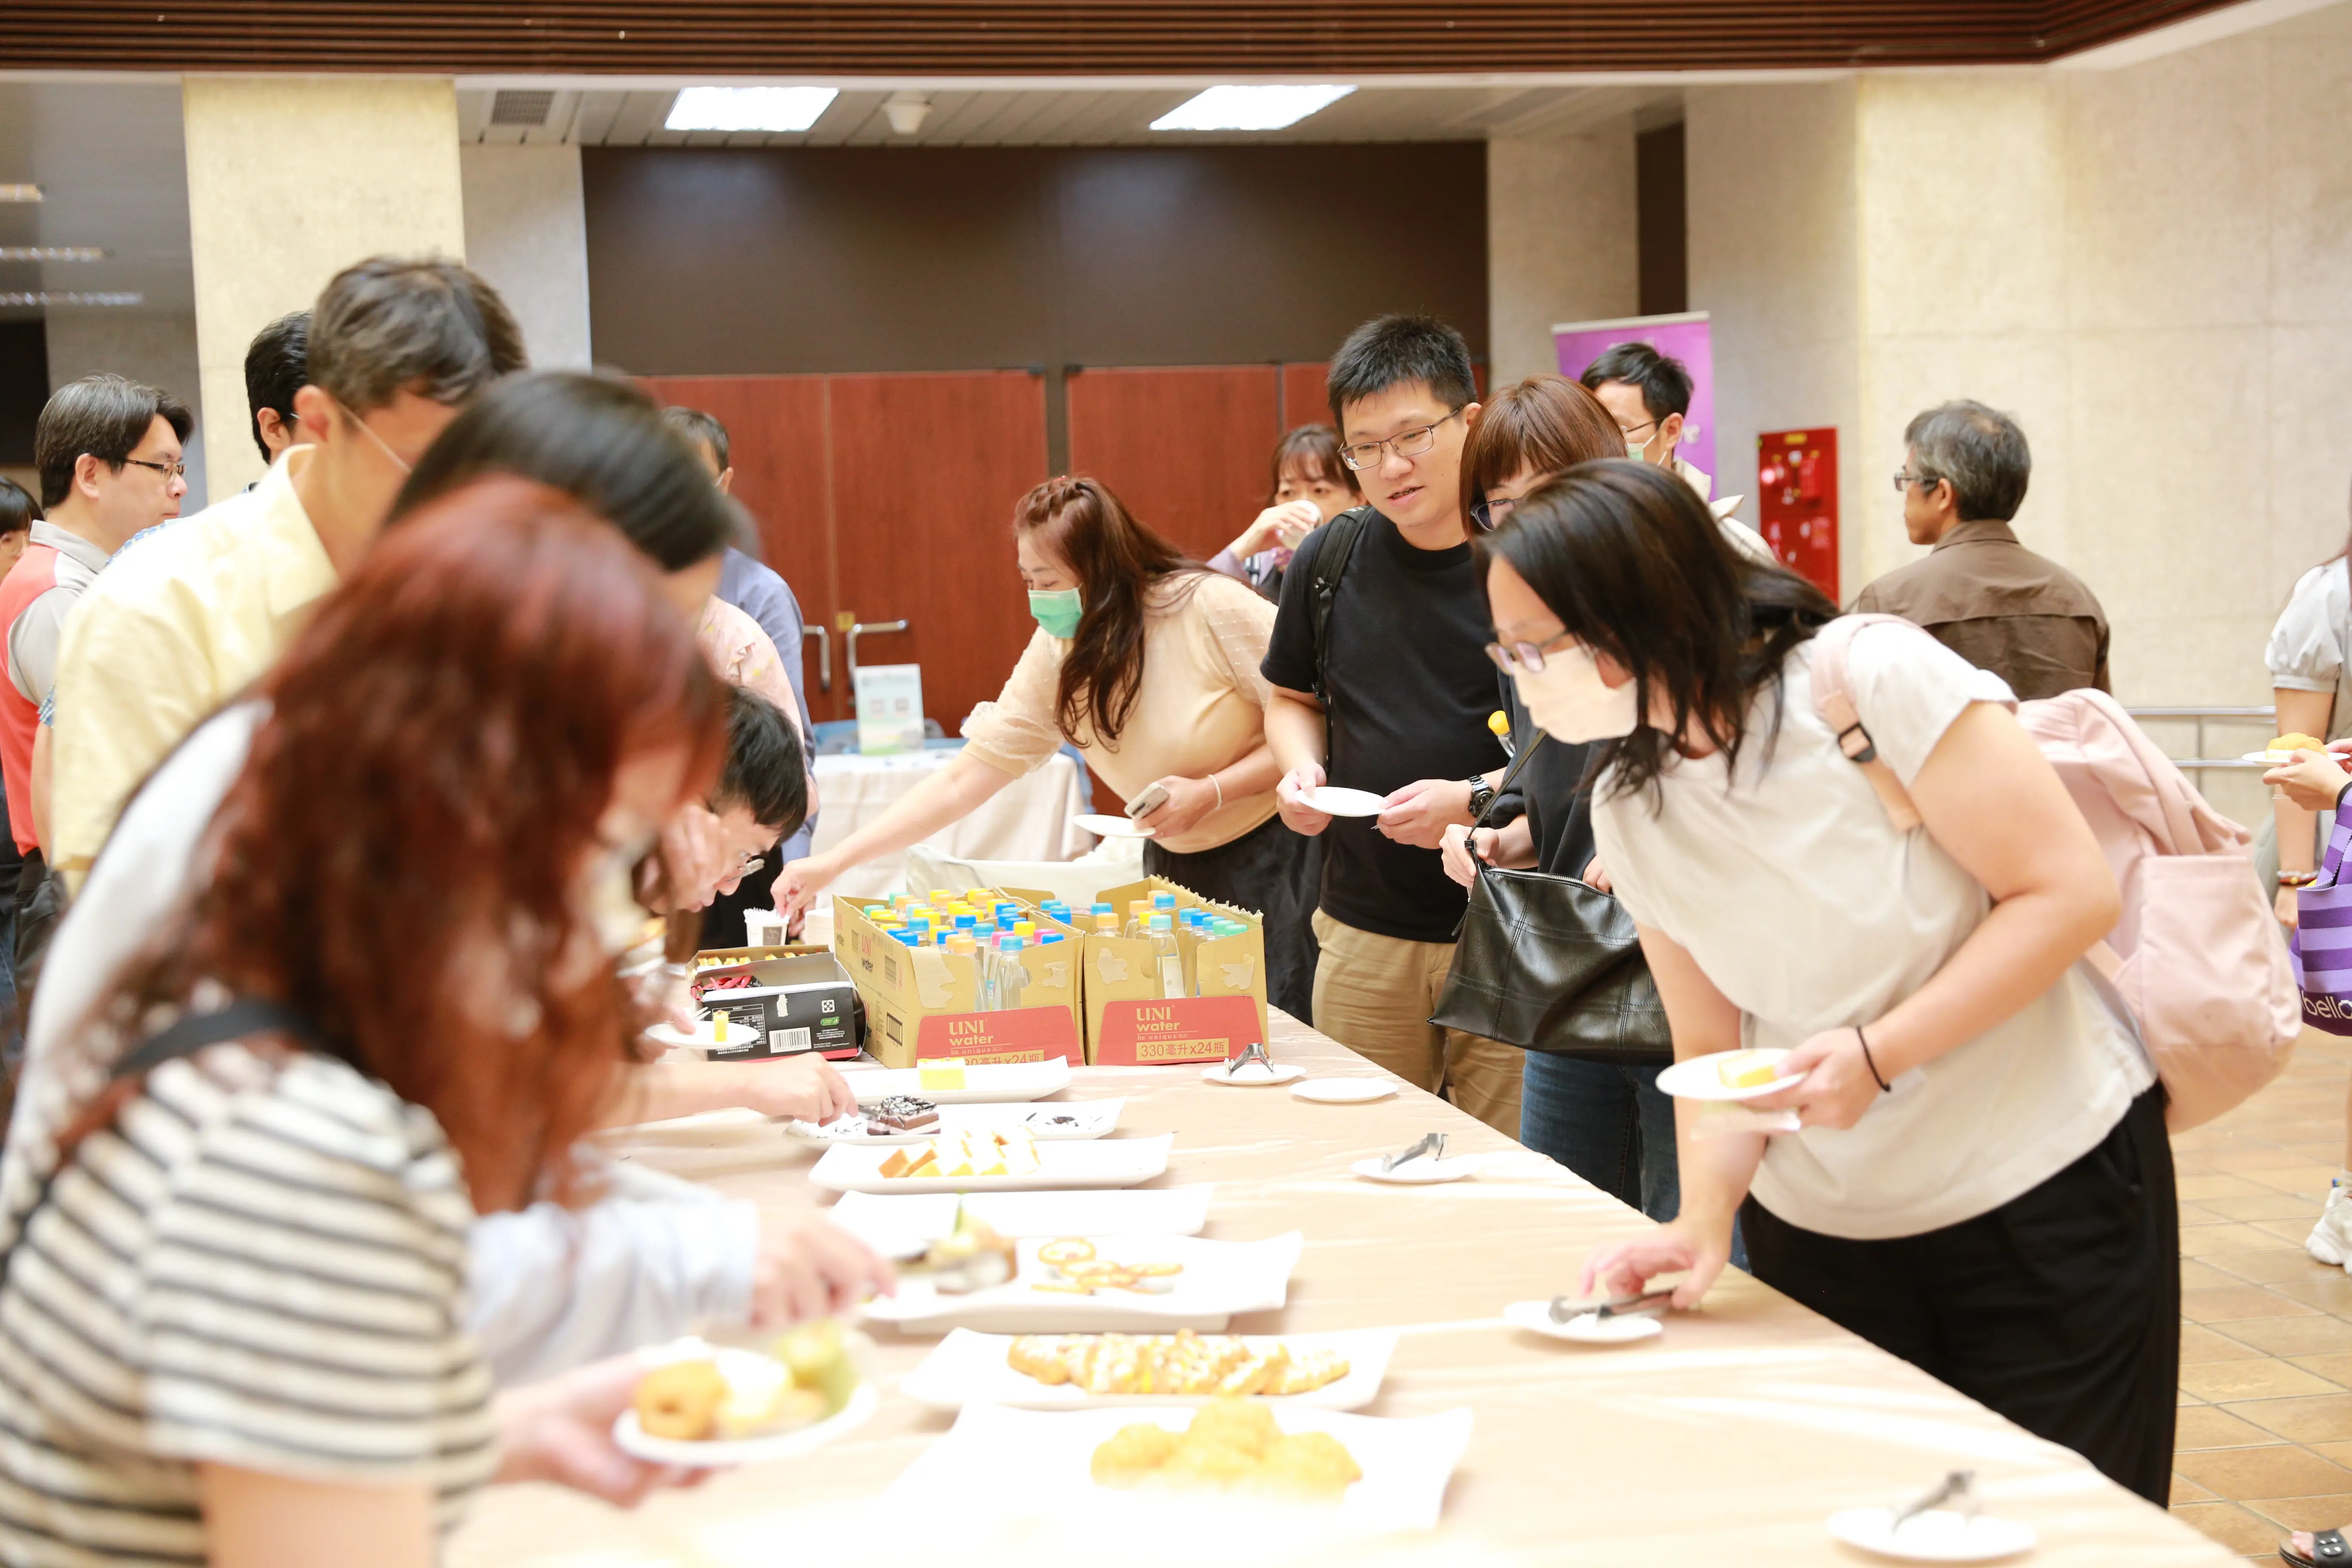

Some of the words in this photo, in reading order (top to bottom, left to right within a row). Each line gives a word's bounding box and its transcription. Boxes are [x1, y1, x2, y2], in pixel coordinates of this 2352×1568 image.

[862, 934, 871, 956] UNI
[861, 957, 873, 973] water
[1136, 1006, 1171, 1021] UNI
[949, 1020, 985, 1035] UNI
[1136, 1021, 1180, 1032] water
[949, 1035, 994, 1046] water
